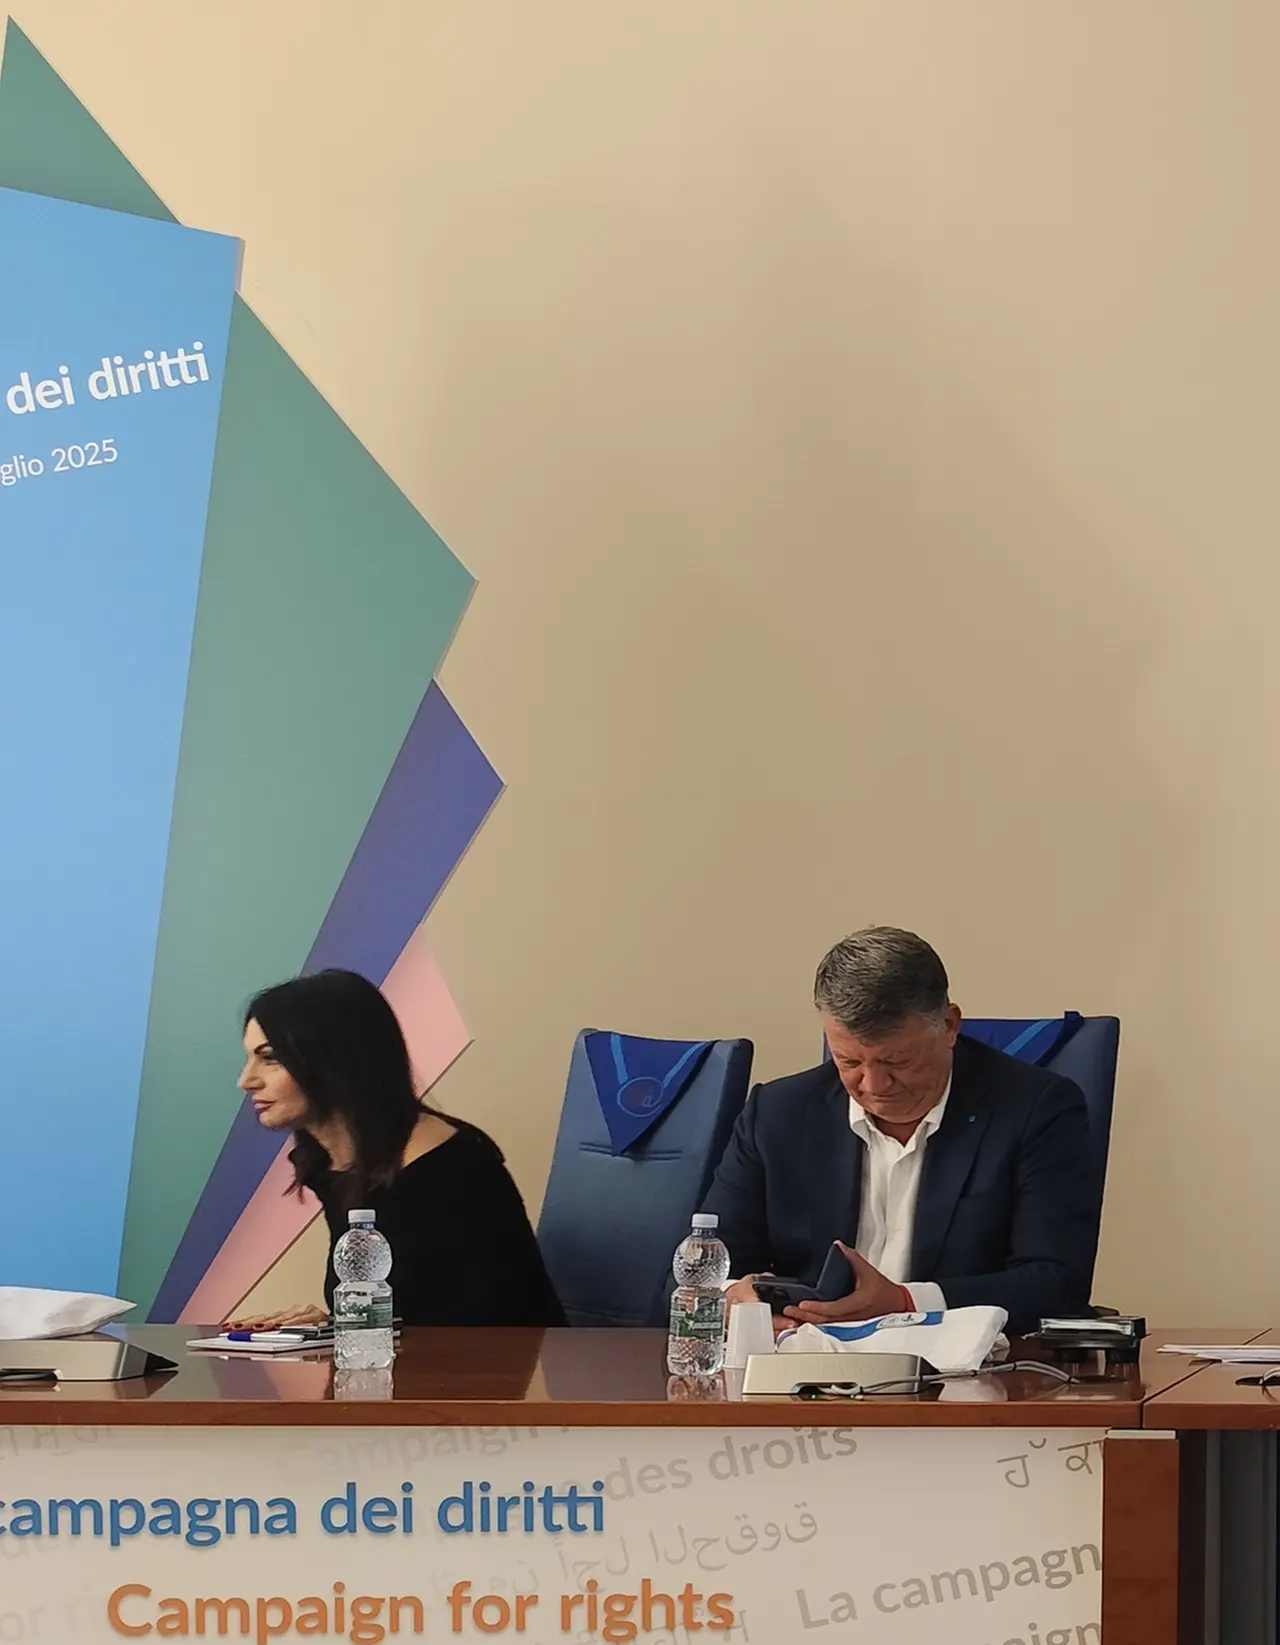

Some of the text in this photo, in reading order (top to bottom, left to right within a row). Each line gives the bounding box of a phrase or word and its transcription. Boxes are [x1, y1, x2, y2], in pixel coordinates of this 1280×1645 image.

[6, 340, 210, 415] dei diritti
[51, 438, 119, 472] 2025
[602, 1455, 694, 1501] des
[321, 1481, 413, 1535] dei
[437, 1480, 605, 1534] diritti
[107, 1581, 424, 1645] Campaign
[446, 1580, 540, 1633] for
[560, 1578, 735, 1643] rights
[796, 1587, 858, 1631] La
